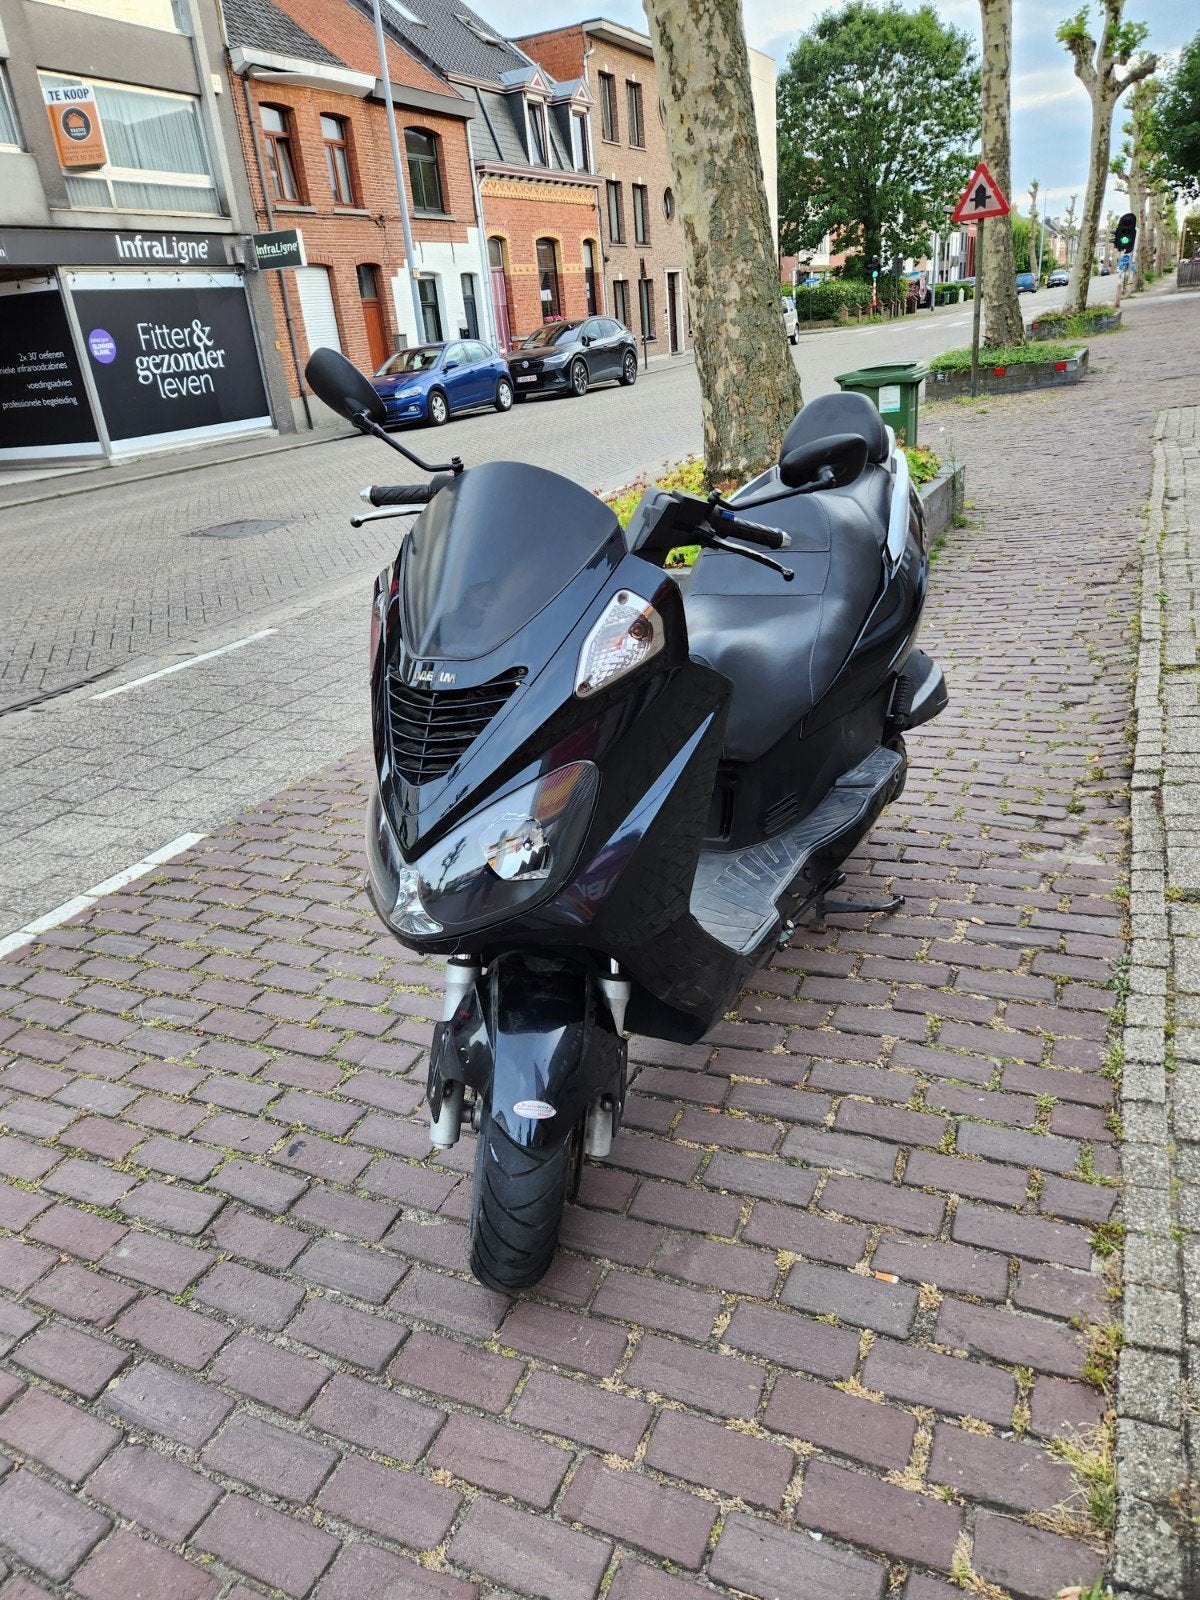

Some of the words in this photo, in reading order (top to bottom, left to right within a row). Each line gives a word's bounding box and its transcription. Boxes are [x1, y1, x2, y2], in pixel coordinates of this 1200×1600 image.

[48, 90, 62, 101] TE
[63, 88, 90, 101] KOOP
[115, 234, 209, 264] InfraLigne
[255, 241, 298, 256] InfraLigne
[17, 353, 27, 362] 2x
[38, 350, 65, 360] oefenen
[0, 366, 16, 375] nieke
[16, 362, 68, 373] infraroodcabines
[135, 345, 226, 385] gezonder
[27, 379, 73, 390] voedingsadvies
[156, 372, 215, 399] leven
[2, 398, 42, 411] professionele
[42, 396, 79, 408] begeleiding
